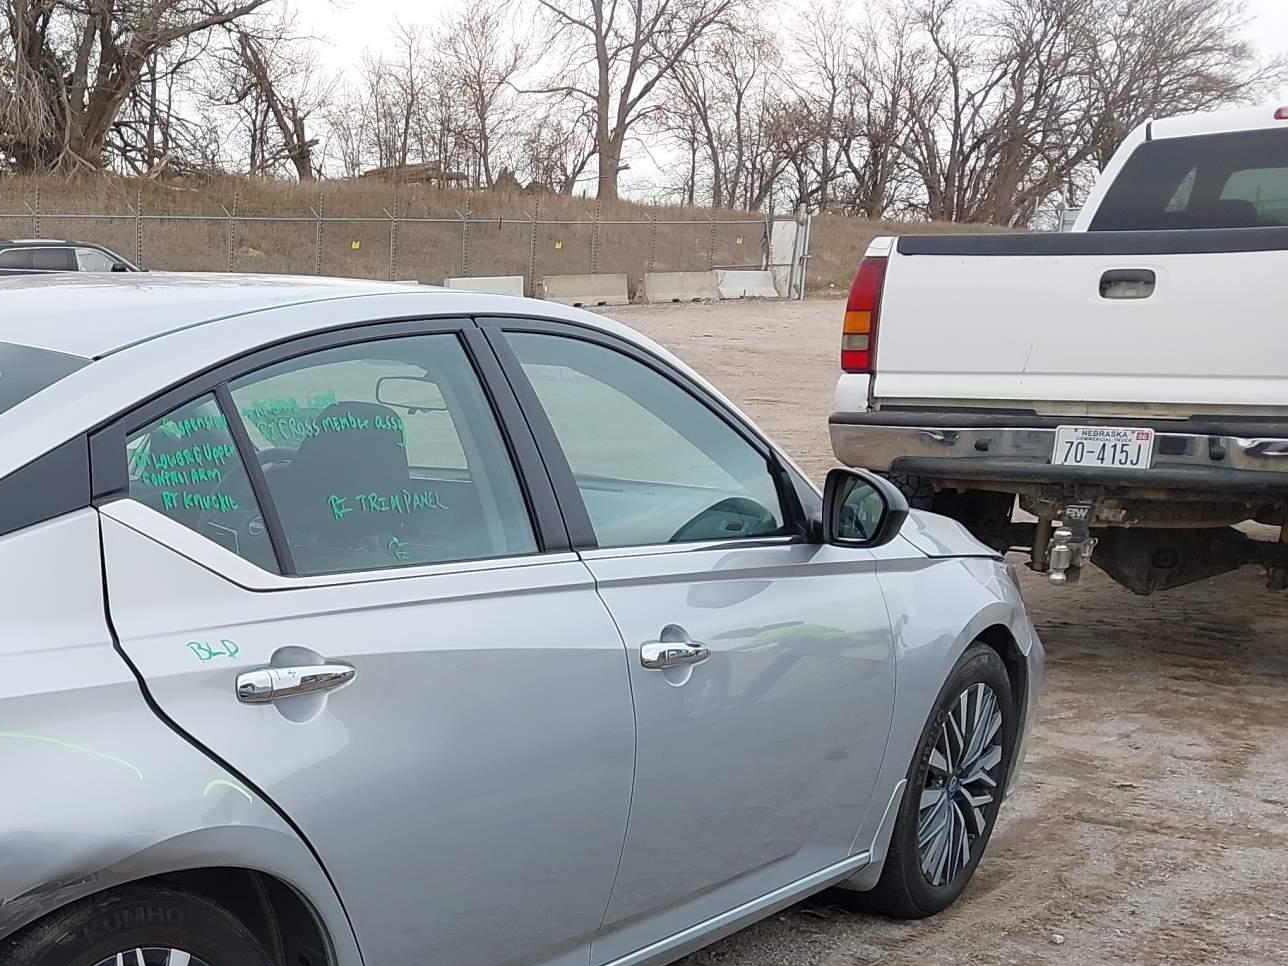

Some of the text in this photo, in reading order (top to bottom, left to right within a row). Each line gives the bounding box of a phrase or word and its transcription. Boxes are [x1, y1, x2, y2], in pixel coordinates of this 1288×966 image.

[1081, 430, 1128, 438] NEBRASKA
[1063, 441, 1142, 466] 70-415J
[185, 637, 240, 663] BLD
